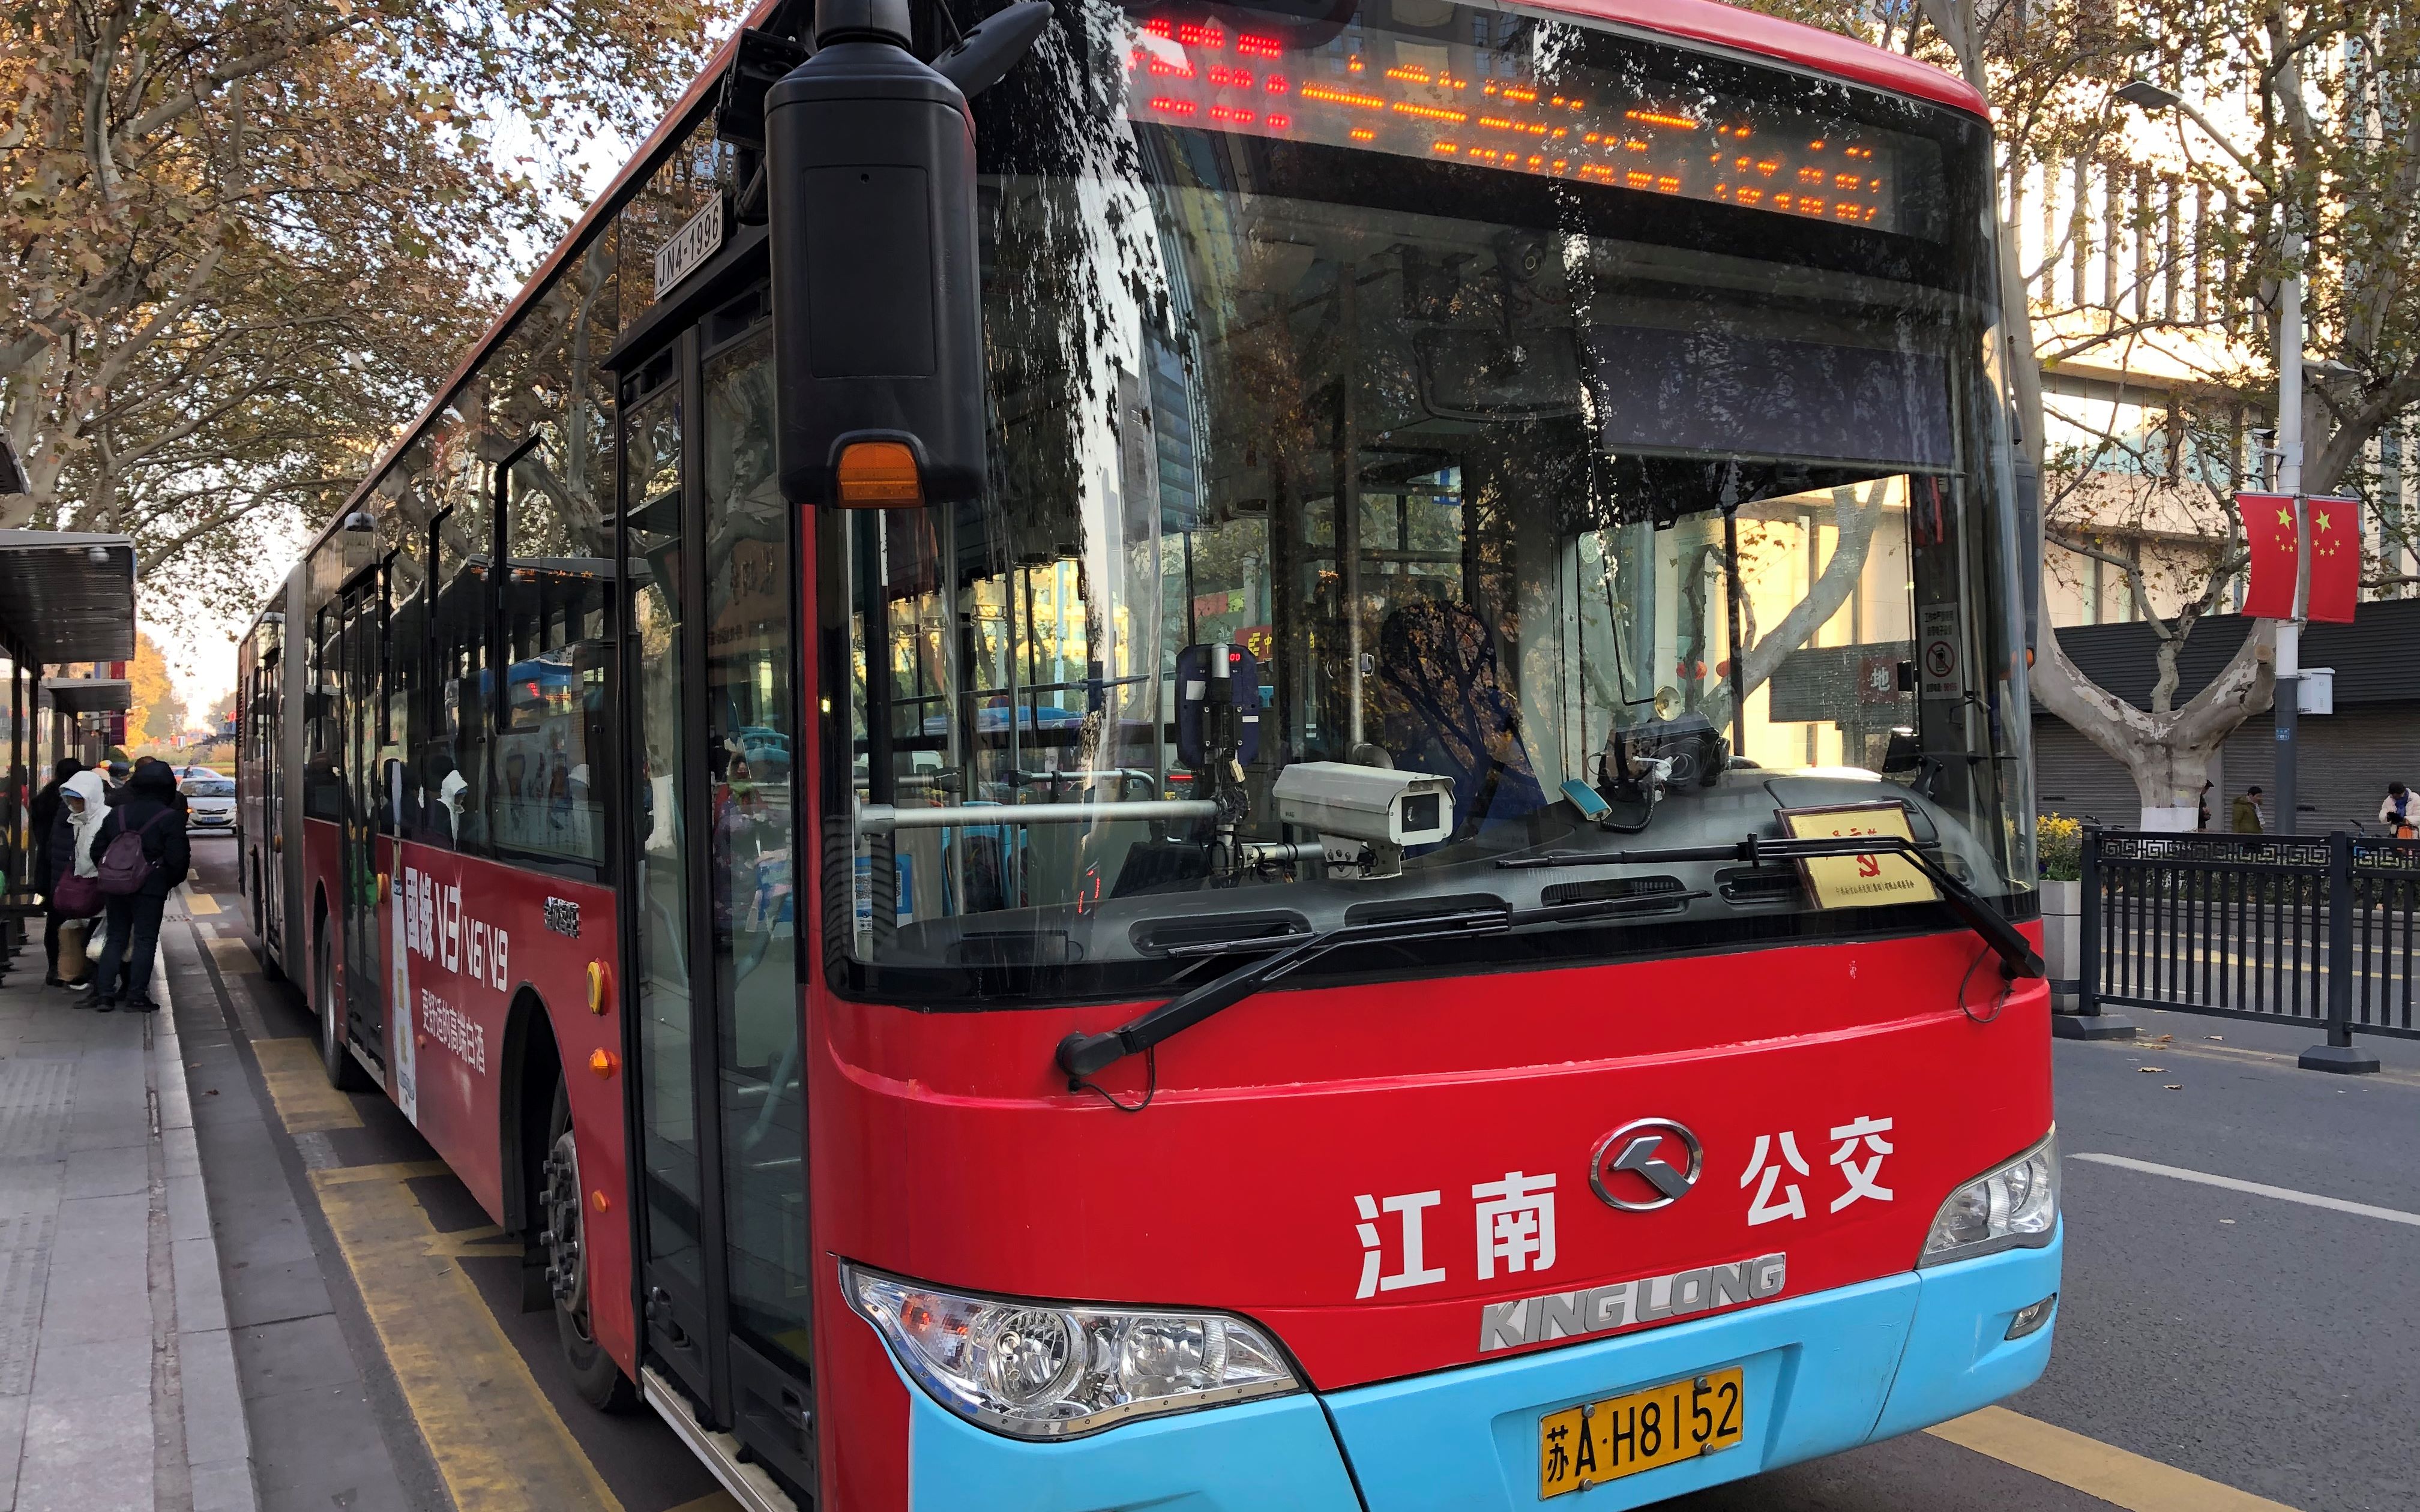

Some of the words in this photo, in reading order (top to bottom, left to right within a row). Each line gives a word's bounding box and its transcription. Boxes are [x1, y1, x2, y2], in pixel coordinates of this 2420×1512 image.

[658, 205, 718, 287] JN4-1996
[421, 987, 486, 1077] 更舒适的高端白酒
[1353, 1171, 1558, 1300] 江南
[1740, 1114, 1894, 1227] 公交
[1479, 1283, 1627, 1353] KING
[1635, 1251, 1787, 1324] LONG
